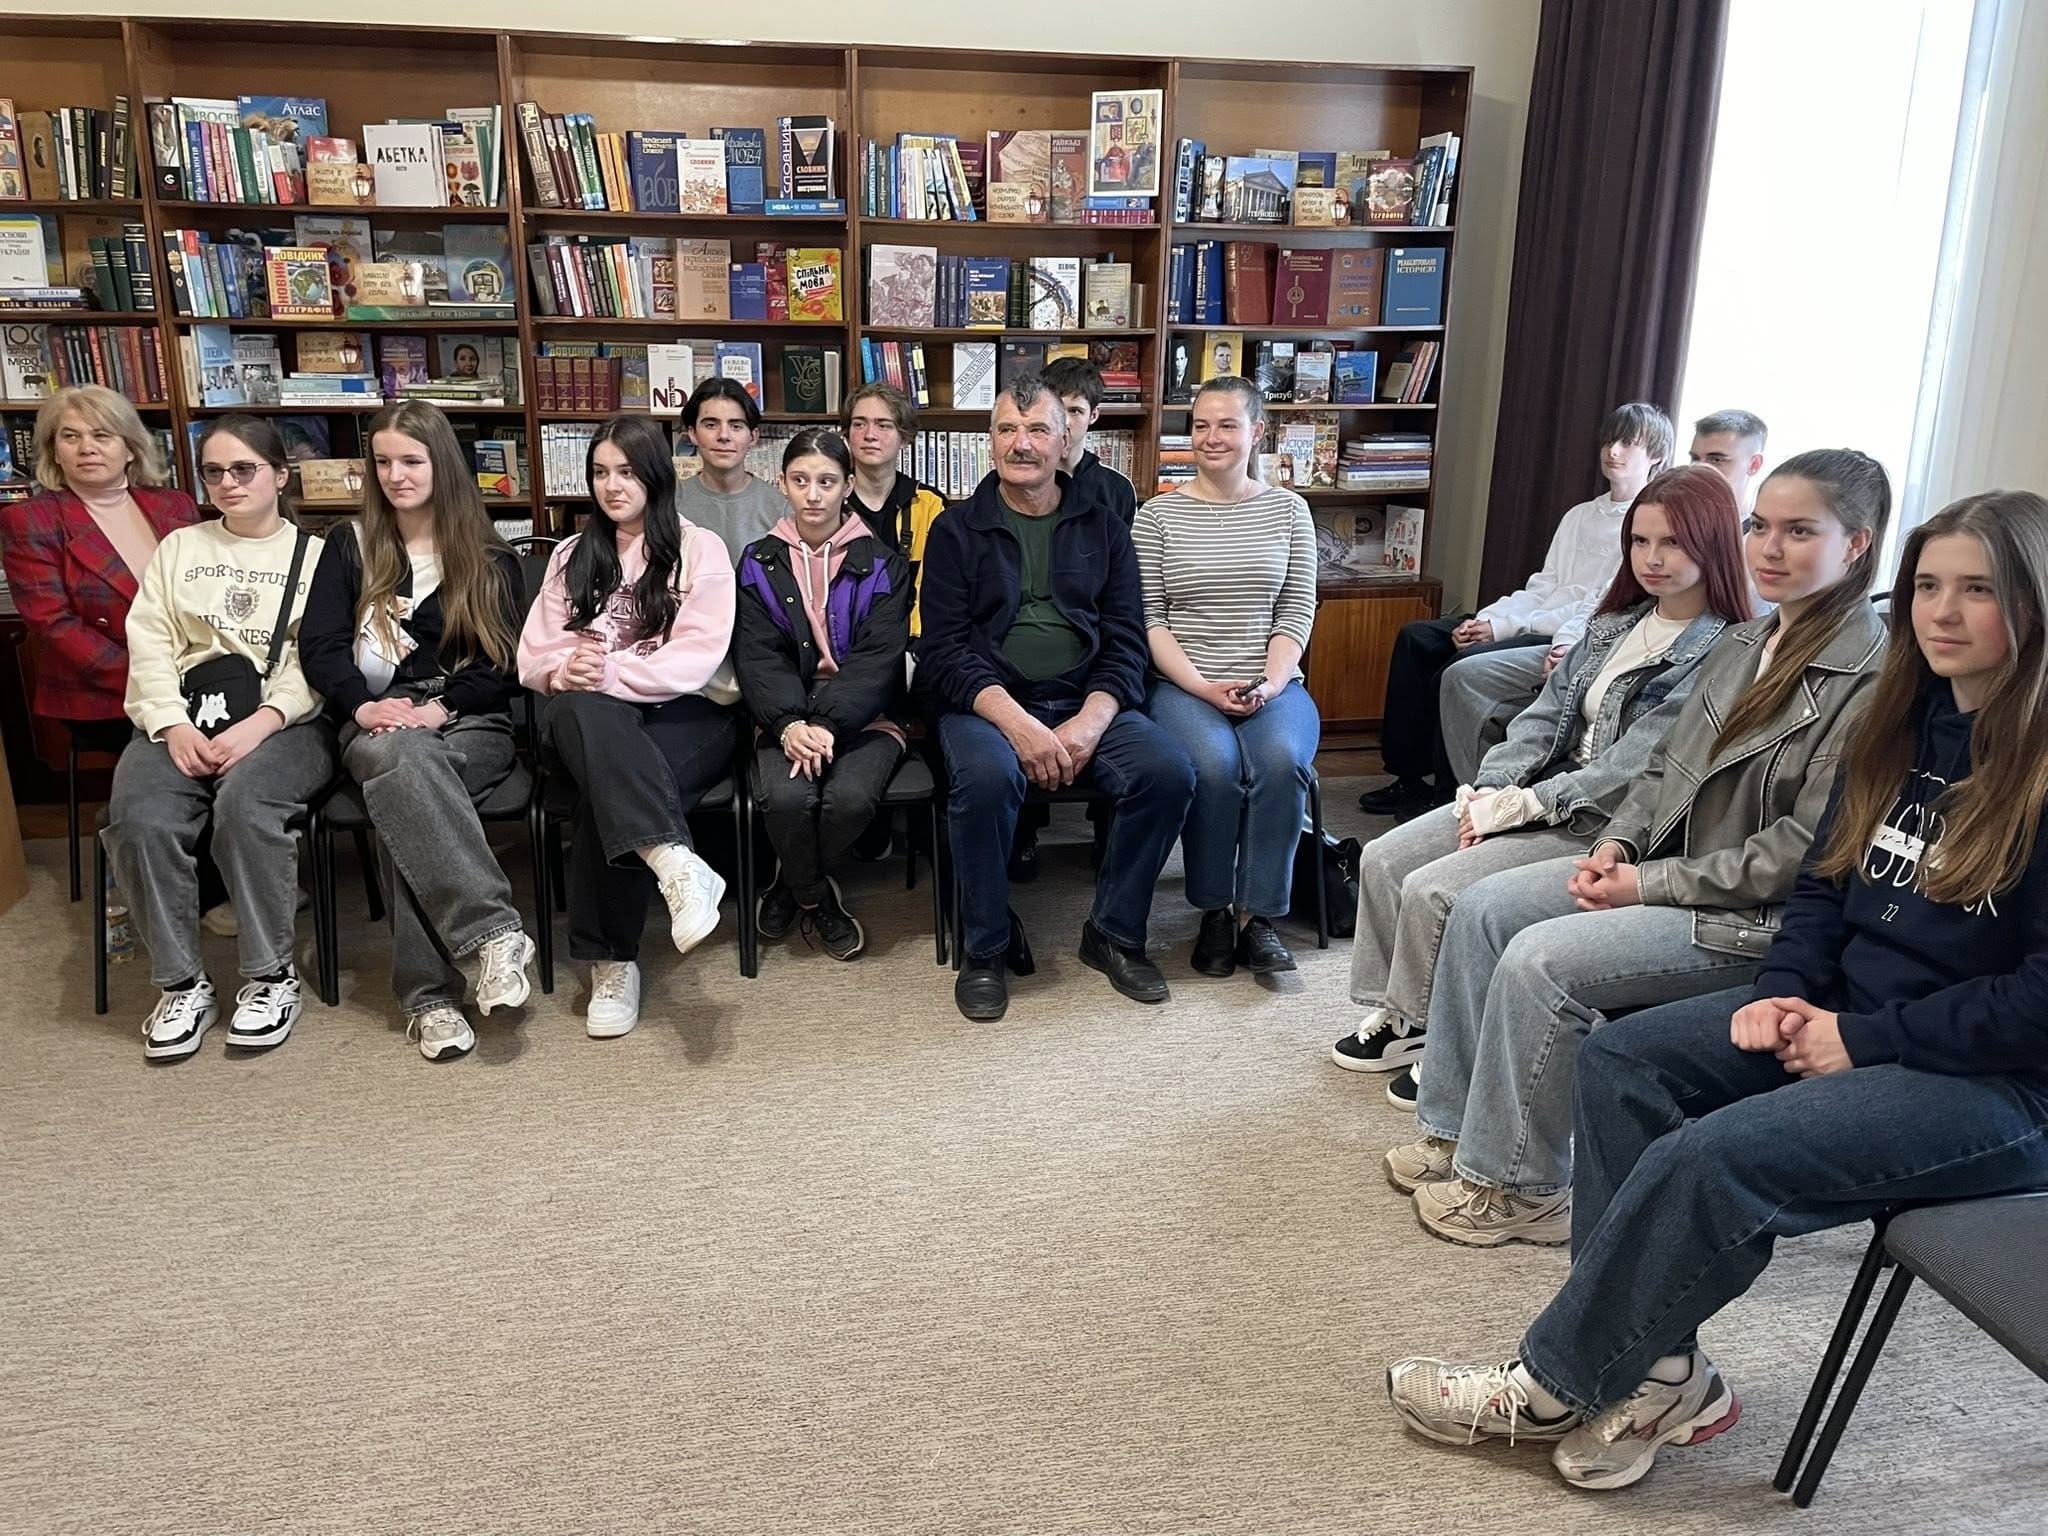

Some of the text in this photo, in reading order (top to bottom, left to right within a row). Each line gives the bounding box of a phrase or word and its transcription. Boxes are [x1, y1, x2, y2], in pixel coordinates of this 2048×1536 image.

[376, 146, 428, 163] АБЕТКА
[272, 251, 326, 262] ДОВІДНИК
[800, 277, 825, 290] МОВА
[278, 306, 332, 314] ГЕОГРАФІЯ
[1264, 390, 1293, 401] Тризуб
[184, 564, 306, 595] SPORTS STUDO
[1881, 904, 1899, 922] 22
